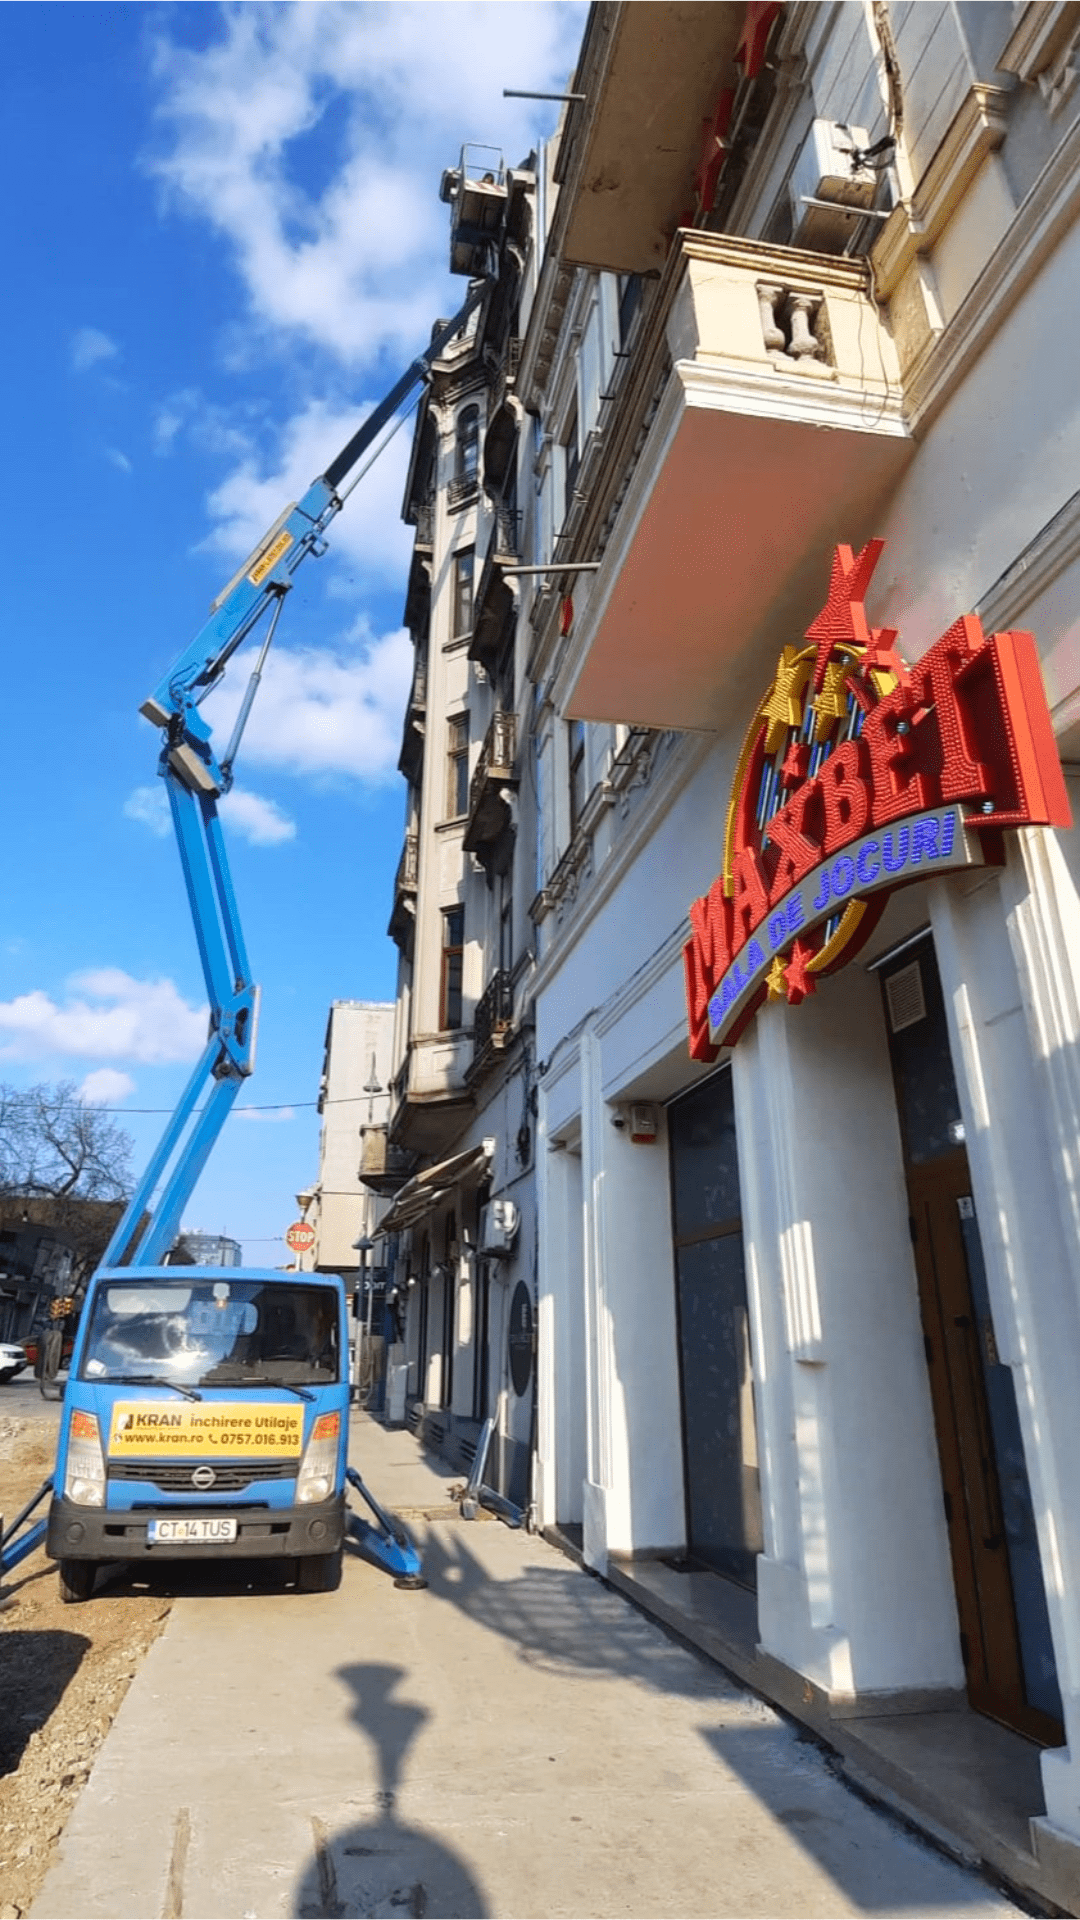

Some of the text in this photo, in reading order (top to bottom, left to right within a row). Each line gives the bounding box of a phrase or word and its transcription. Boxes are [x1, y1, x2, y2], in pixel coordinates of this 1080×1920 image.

[688, 614, 988, 1025] MAXBET
[708, 810, 956, 1028] SALA DE JOCURI
[289, 1230, 315, 1243] STOP
[136, 1413, 182, 1427] KRAN
[254, 1416, 298, 1432] Utilaje
[124, 1432, 300, 1446] www.kran.ro 0757.016.913
[158, 1520, 232, 1538] CT 14 TUS
